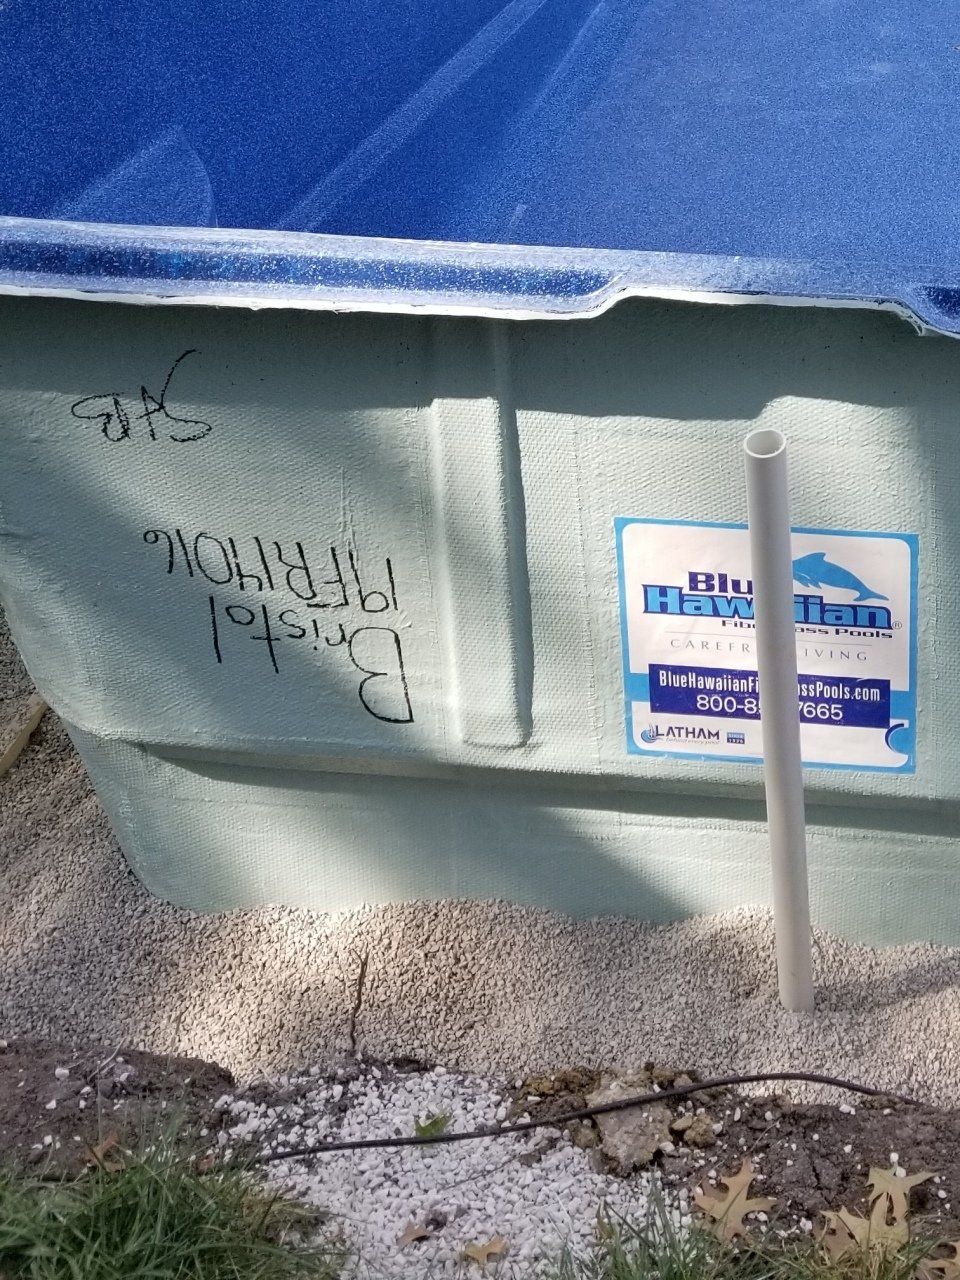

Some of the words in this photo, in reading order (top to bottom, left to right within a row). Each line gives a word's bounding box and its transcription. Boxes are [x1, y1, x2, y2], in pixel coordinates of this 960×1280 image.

[688, 571, 753, 595] Blu
[642, 584, 892, 630] Hawiian
[835, 628, 893, 638] Pools
[209, 596, 414, 723] Bristol
[671, 639, 750, 653] CAREFR
[804, 648, 867, 661] IVING
[655, 725, 720, 740] LATHAM
